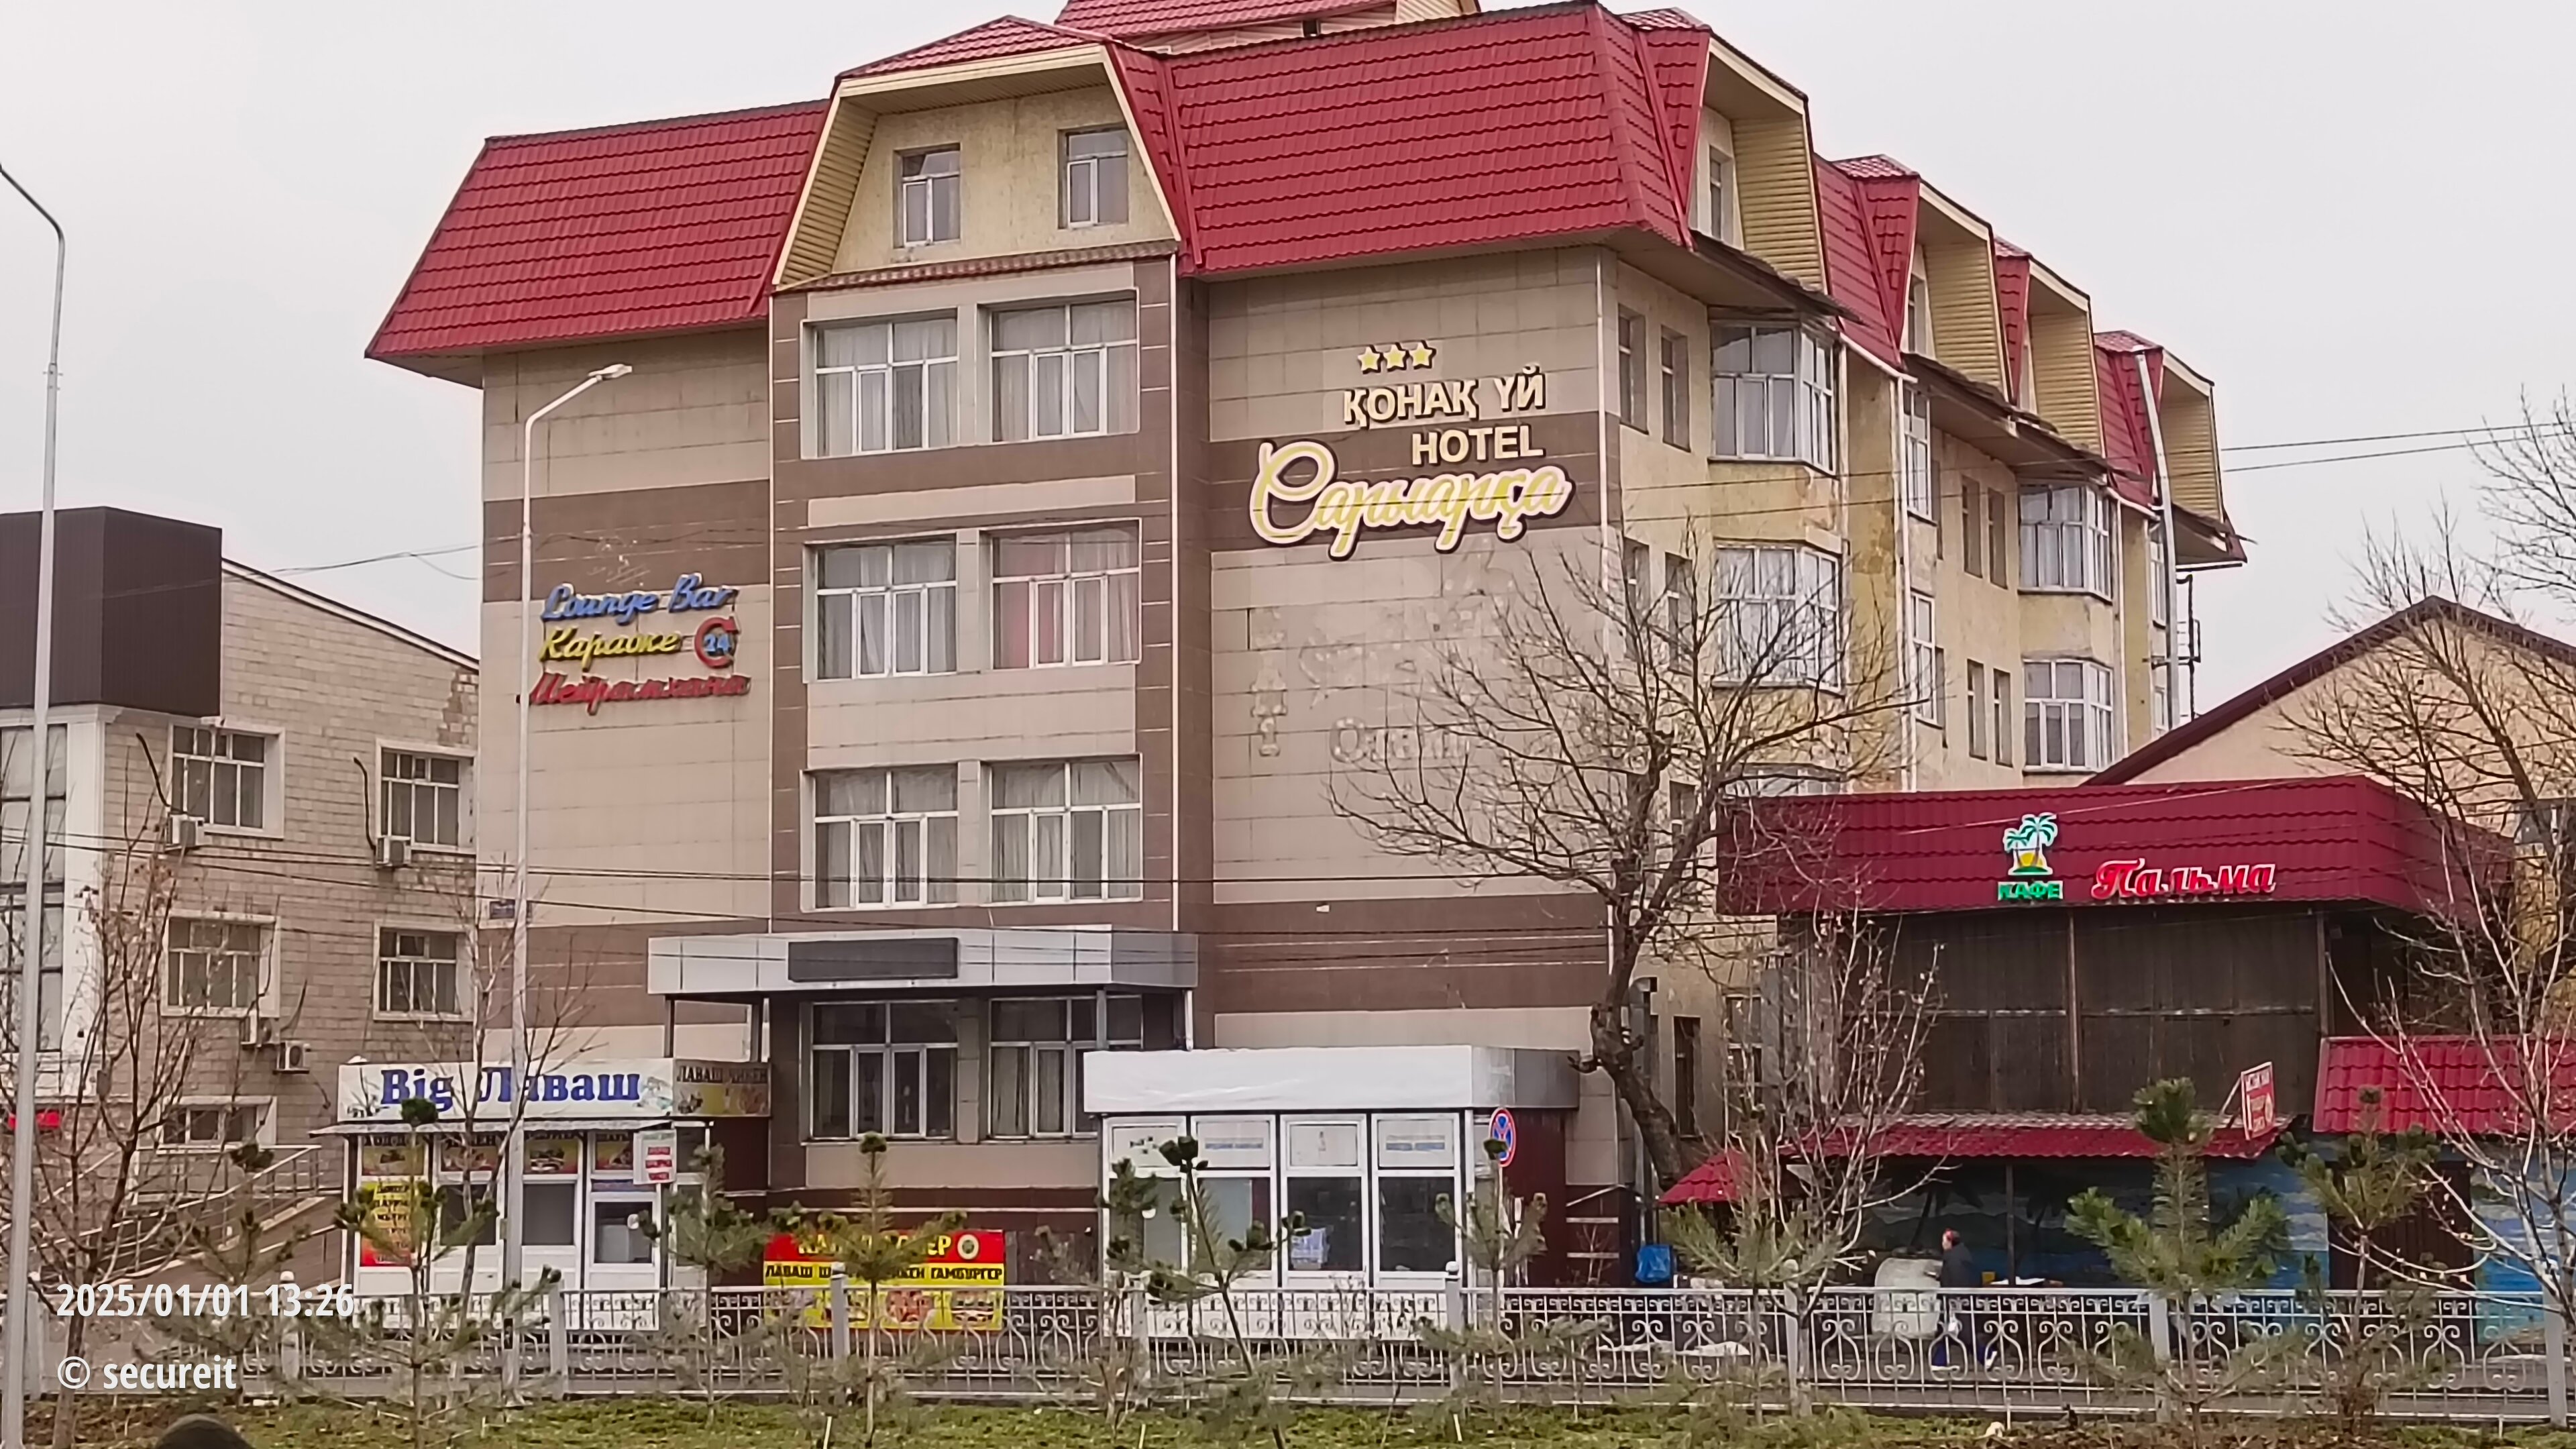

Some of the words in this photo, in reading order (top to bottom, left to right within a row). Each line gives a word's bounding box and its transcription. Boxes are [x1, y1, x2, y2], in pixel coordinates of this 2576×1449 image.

[1344, 379, 1479, 429] ҚОНАҚ
[1493, 363, 1546, 411] ҮЙ
[1412, 425, 1544, 466] HOTEL
[1250, 440, 1576, 561] Сарыарқа
[541, 582, 661, 626] Lounge
[669, 572, 739, 613] Bar
[539, 625, 682, 672] Караоке
[704, 633, 733, 656] 24
[1998, 881, 2063, 902] КАФЕ
[2091, 858, 2276, 900] Пальма
[380, 1069, 455, 1112] Big
[676, 1065, 723, 1083] ЛАВАШ
[765, 1265, 813, 1279] ЛАВАШ
